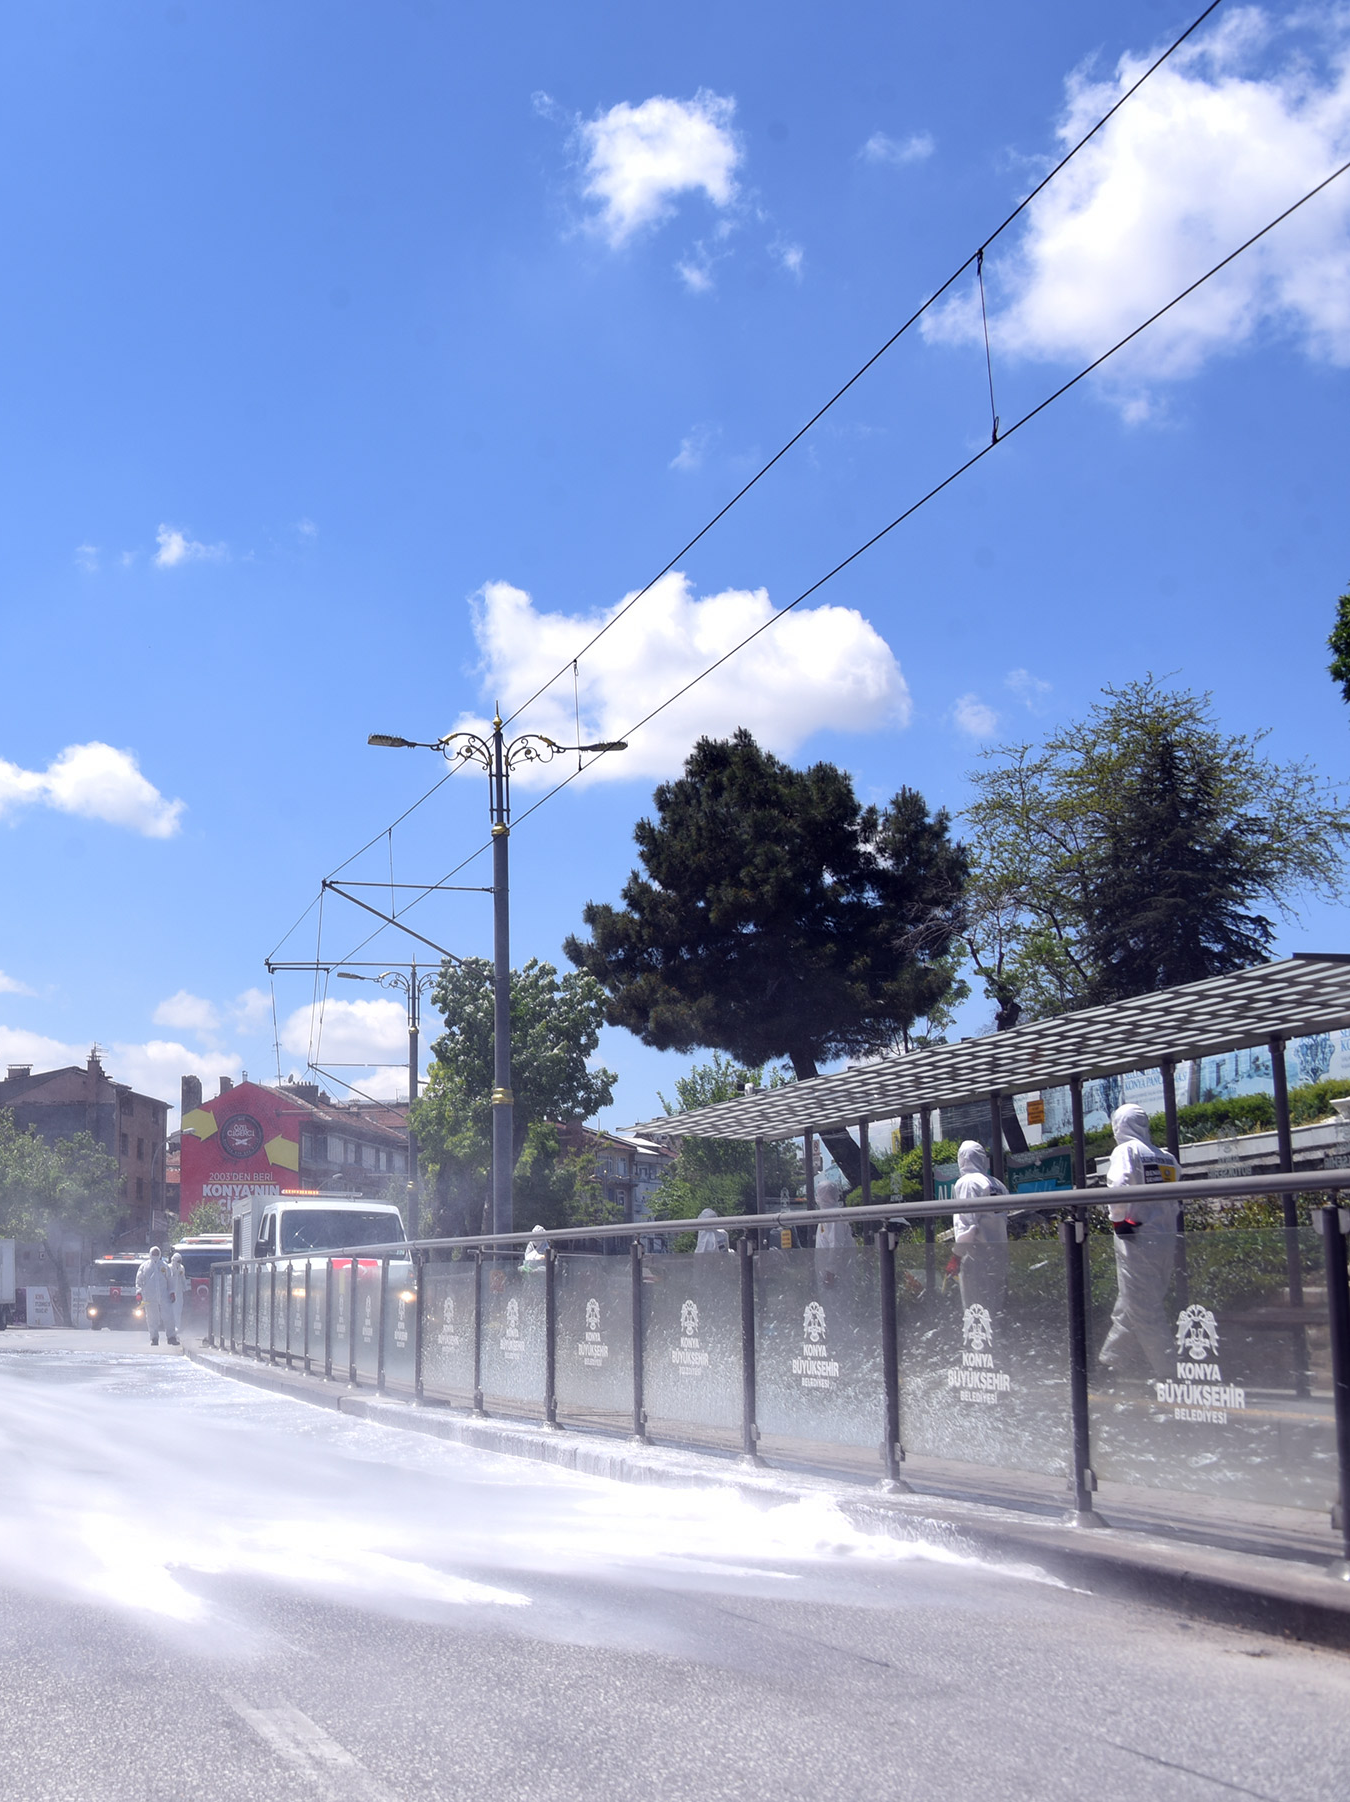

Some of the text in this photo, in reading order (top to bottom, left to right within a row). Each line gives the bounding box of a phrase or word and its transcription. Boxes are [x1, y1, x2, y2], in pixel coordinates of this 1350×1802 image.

[209, 1171, 272, 1181] 2003'DEN BERİ
[202, 1184, 280, 1197] KONYA'NIN
[803, 1344, 827, 1357] KONYA
[792, 1356, 839, 1377] BÜYÜKŞEHİR
[962, 1352, 994, 1368] KONYA
[947, 1366, 1010, 1391] BÜYÜKŞEHİR
[1176, 1362, 1221, 1381] KONYA
[960, 1390, 998, 1404] BELEDİYESİ
[1155, 1379, 1245, 1409] BÜYÜKŞEHİR
[1174, 1407, 1227, 1424] BELEDİYESİ
